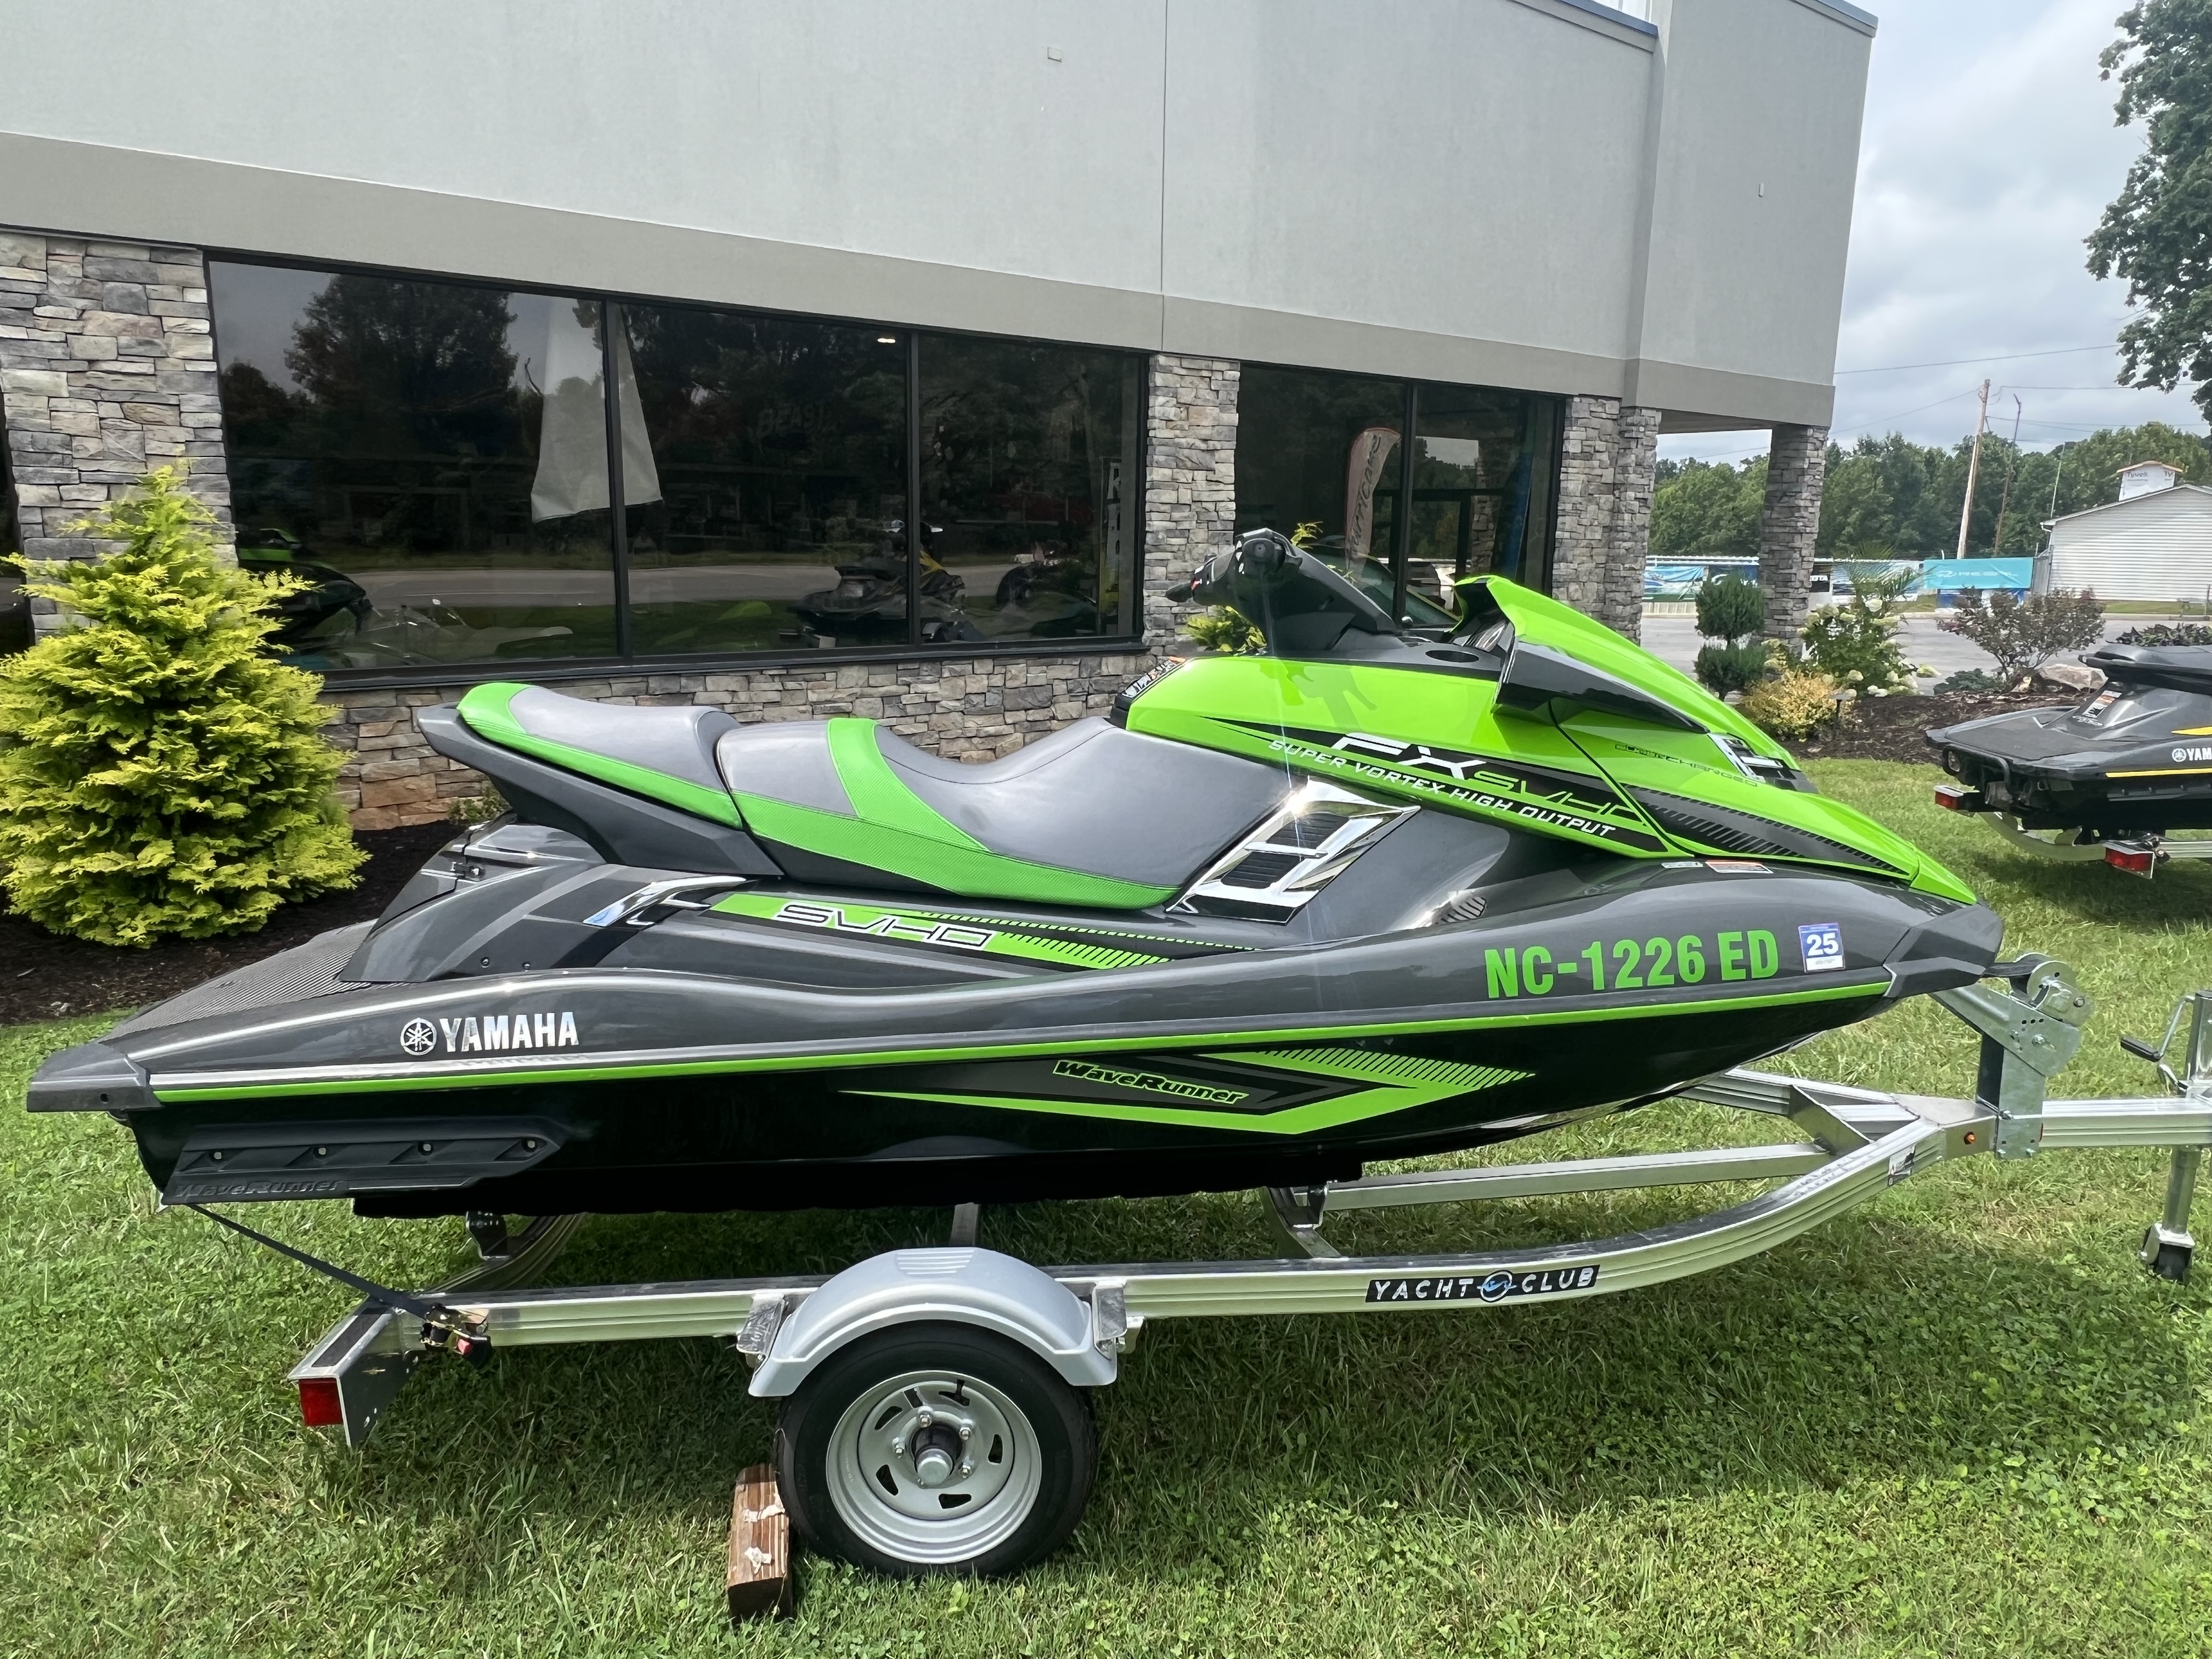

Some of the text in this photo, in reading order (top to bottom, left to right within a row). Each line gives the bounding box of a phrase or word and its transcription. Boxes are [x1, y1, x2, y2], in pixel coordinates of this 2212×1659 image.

[1331, 732, 1487, 780] FX
[1268, 740, 1616, 836] SUPER VORTEX HIGH OUTPUT
[772, 901, 996, 950] SVHO
[1807, 933, 1838, 956] 25
[1485, 930, 1779, 998] NC-1226 ED
[439, 1012, 579, 1052] YAMAHA
[1053, 1060, 1250, 1104] WaveRunner
[1375, 1267, 1594, 1300] YACHT CLUB
